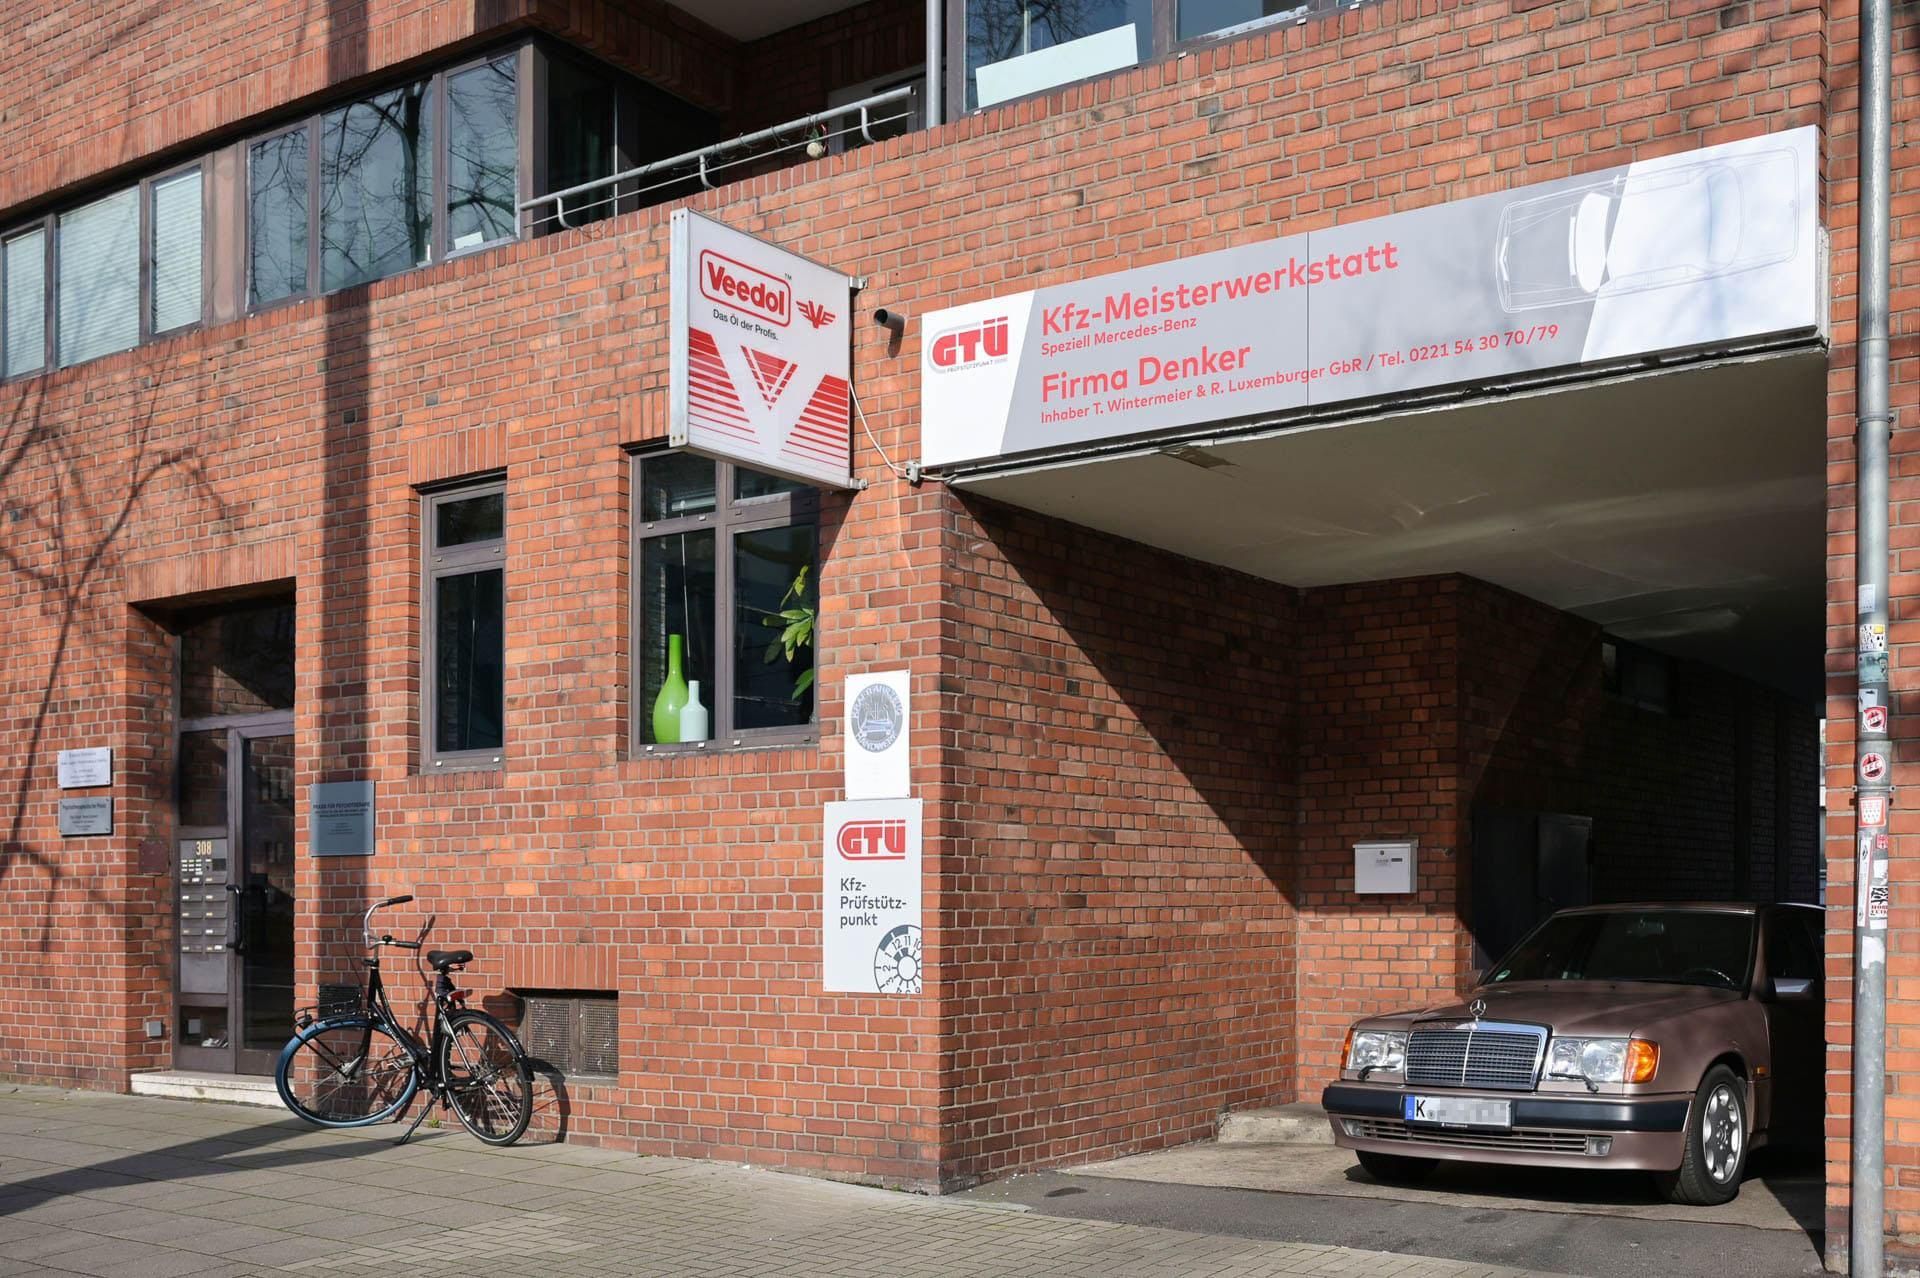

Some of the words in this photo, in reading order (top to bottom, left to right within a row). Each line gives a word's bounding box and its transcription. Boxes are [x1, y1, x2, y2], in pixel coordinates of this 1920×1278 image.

[707, 261, 785, 316] Veedol
[1042, 242, 1398, 336] Kfz-Meisterwerkstatt
[713, 309, 728, 322] Das
[730, 315, 739, 326] Öl
[740, 319, 753, 331] der
[932, 316, 1008, 367] GTÜ
[1041, 335, 1090, 357] Speziell
[1094, 317, 1197, 344] Mercedes-Benz
[1041, 407, 1090, 423] Inhaber
[1093, 402, 1104, 415] T.
[1108, 388, 1193, 412] Wintermeier
[1196, 384, 1206, 397] &
[1211, 382, 1224, 395] R.
[1228, 367, 1324, 392] Luxemburger
[1329, 358, 1362, 375] GbR
[1379, 351, 1405, 367] Tel.
[1409, 343, 1449, 361] 0221
[1454, 339, 1474, 354] 54
[1479, 335, 1499, 350] 30
[1504, 324, 1559, 346] 70/79
[1042, 369, 1128, 403] Firma
[1139, 345, 1251, 386] Denker
[196, 841, 211, 855] 308
[842, 819, 906, 854] GTÜ
[840, 877, 866, 891] Kfz-
[840, 895, 907, 909] Prüfstütz-
[840, 912, 878, 929] punkt
[892, 938, 902, 950] 12
[1416, 1099, 1426, 1118] K
